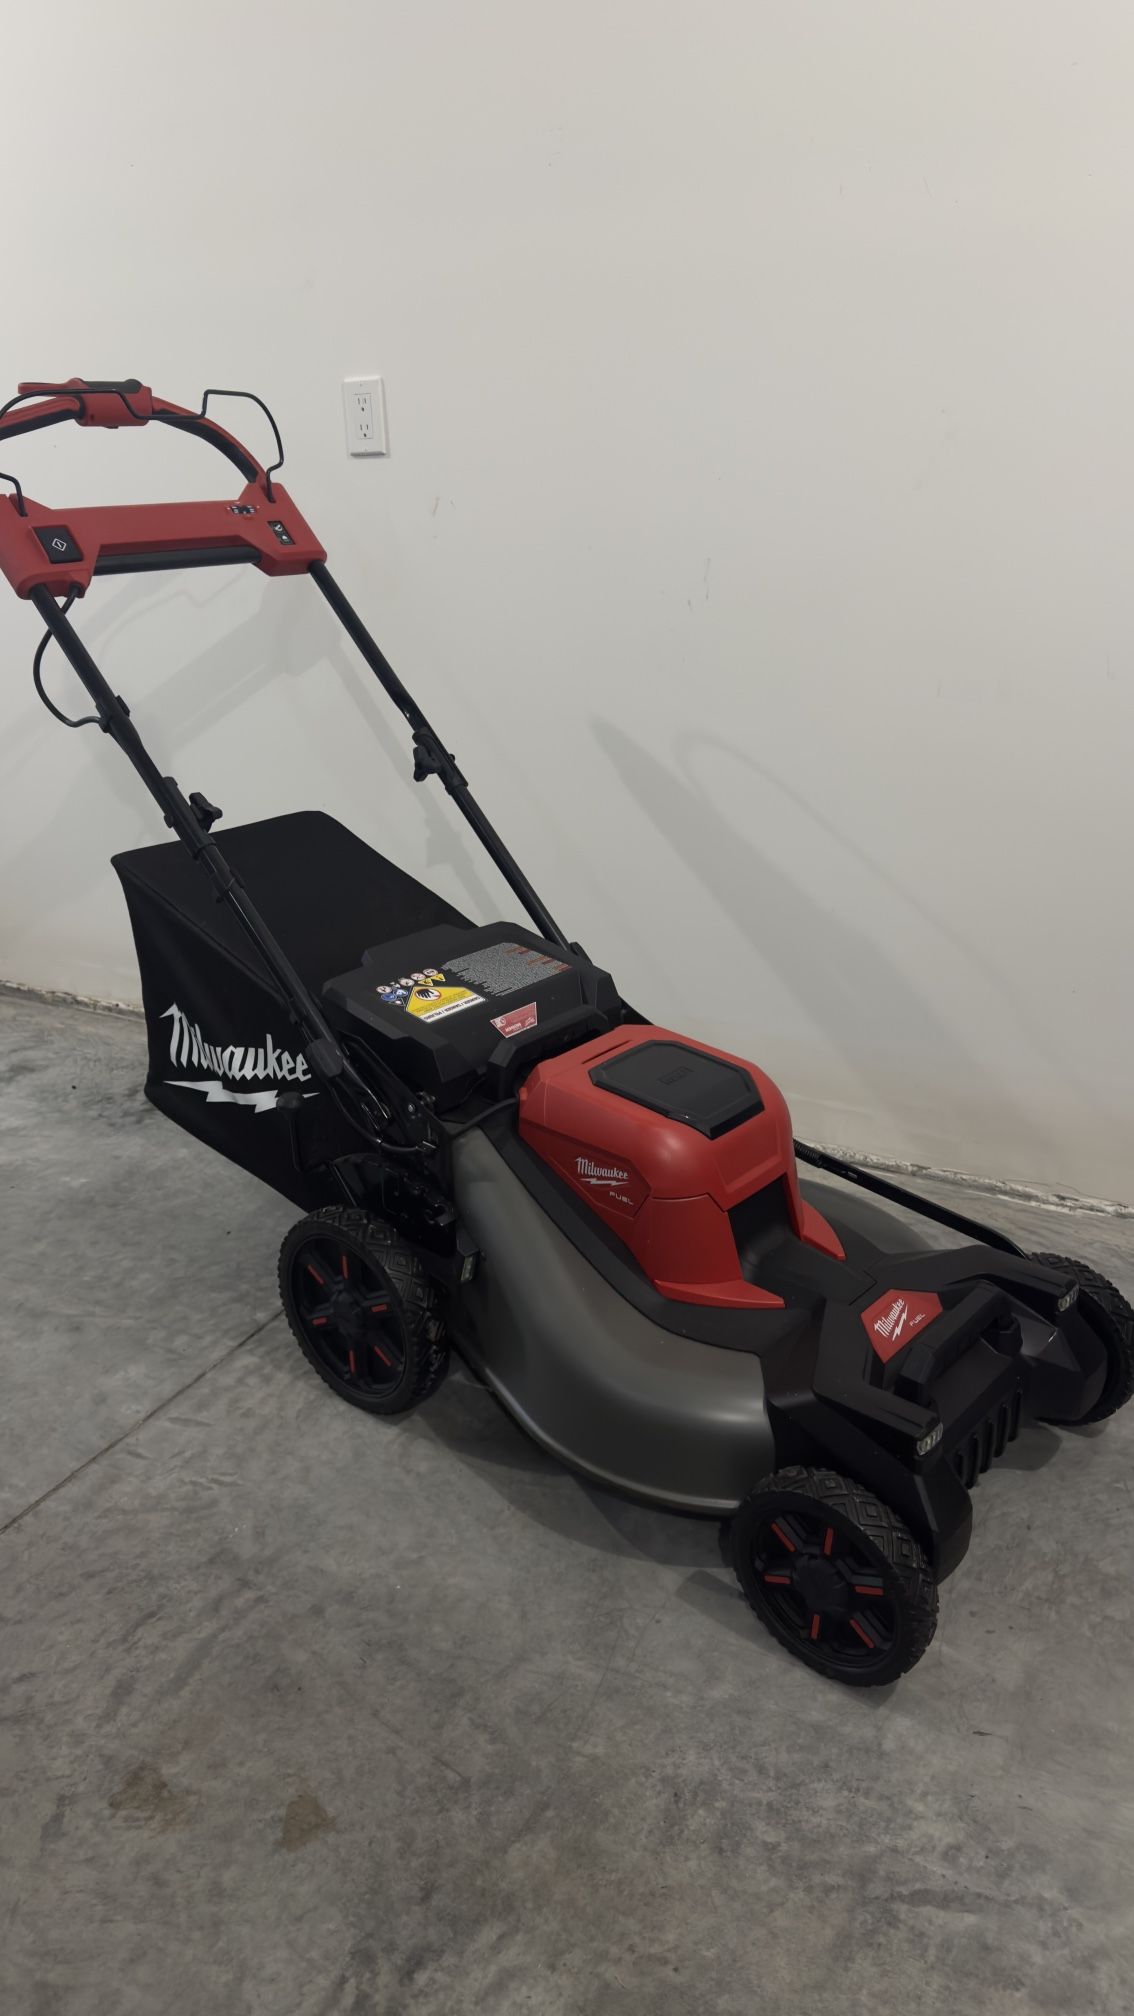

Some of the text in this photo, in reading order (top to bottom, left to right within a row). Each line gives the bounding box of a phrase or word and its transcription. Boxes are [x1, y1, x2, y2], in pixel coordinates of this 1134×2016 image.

[159, 1002, 312, 1081] Milwaukee
[575, 1157, 629, 1179] Milwaukee
[609, 1191, 634, 1205] FUEL
[874, 1298, 905, 1337] Milwaukee
[909, 1313, 926, 1326] FUEL
